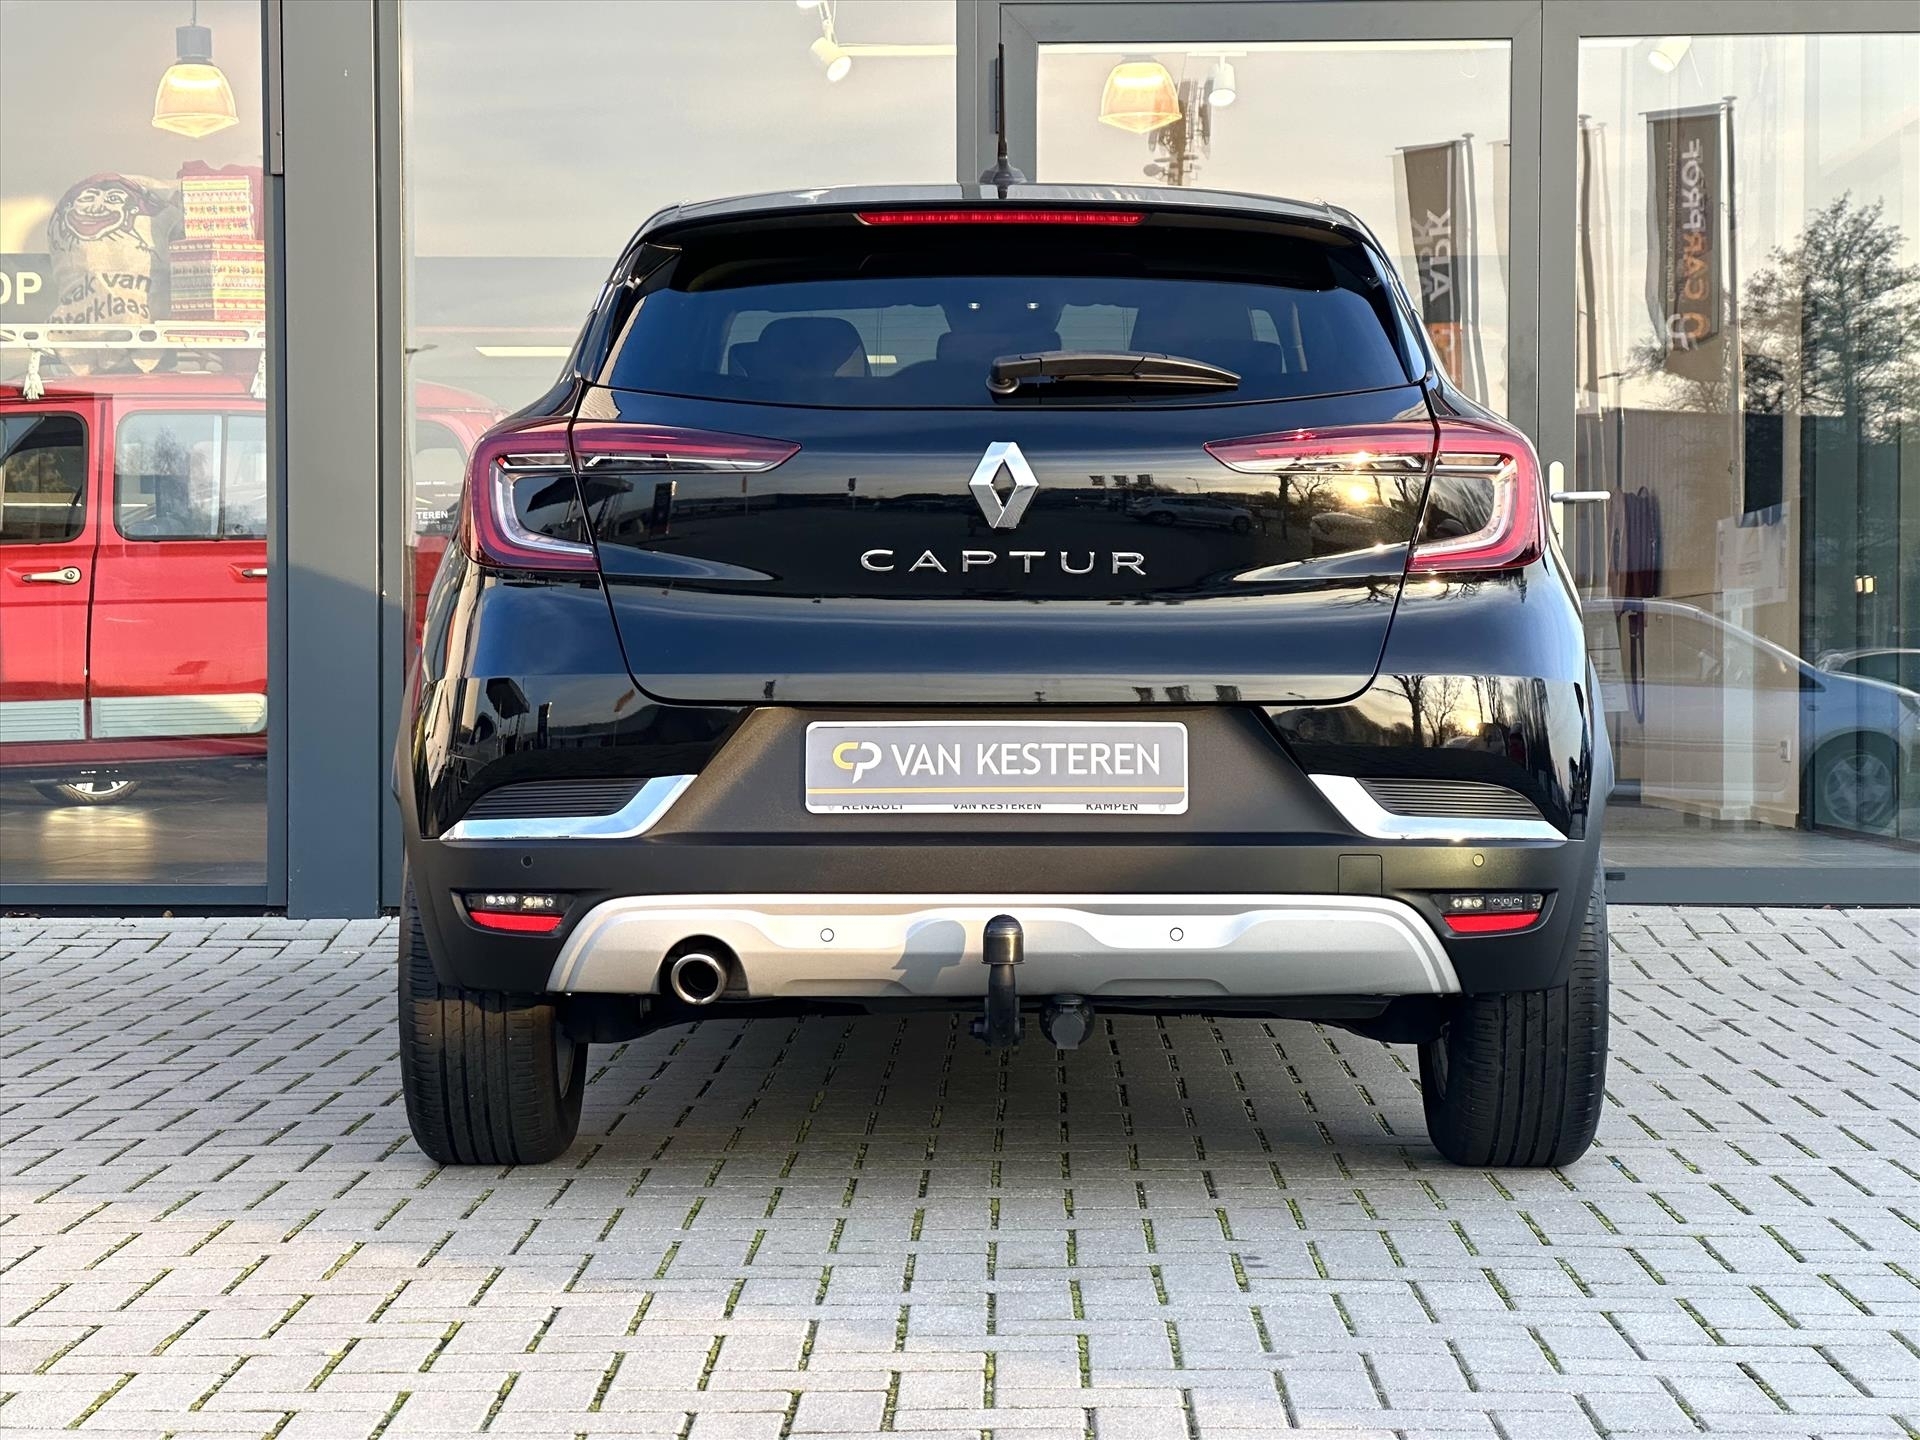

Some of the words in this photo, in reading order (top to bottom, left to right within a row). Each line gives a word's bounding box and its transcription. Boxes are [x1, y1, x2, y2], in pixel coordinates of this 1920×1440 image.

[102, 273, 152, 294] van
[860, 549, 1147, 576] CAPTUR
[891, 743, 961, 776] VAN
[977, 742, 1160, 776] KESTEREN
[1086, 803, 1139, 811] KAMPEN
